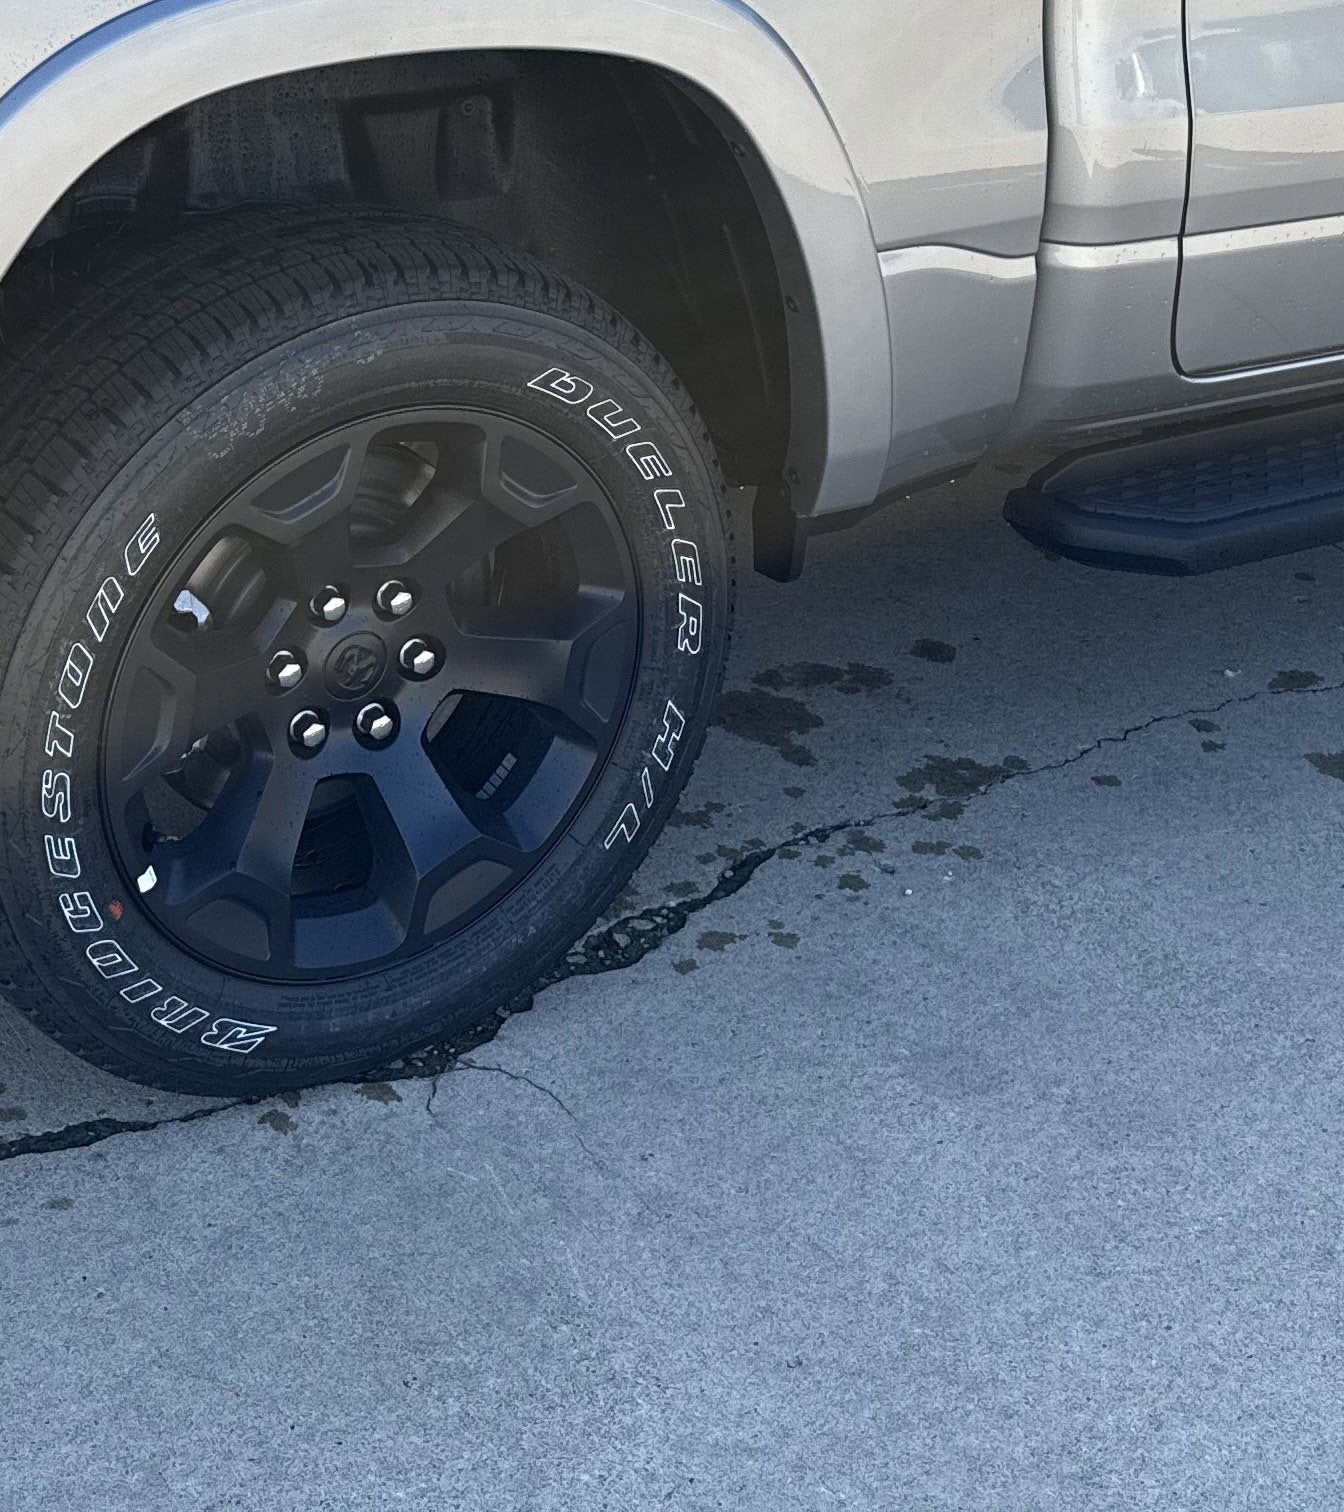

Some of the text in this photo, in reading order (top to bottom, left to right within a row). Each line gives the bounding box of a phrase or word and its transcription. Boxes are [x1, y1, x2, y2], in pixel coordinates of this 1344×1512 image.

[42, 512, 278, 1054] BRIDGESTONE
[527, 367, 703, 850] DUELER H/L
